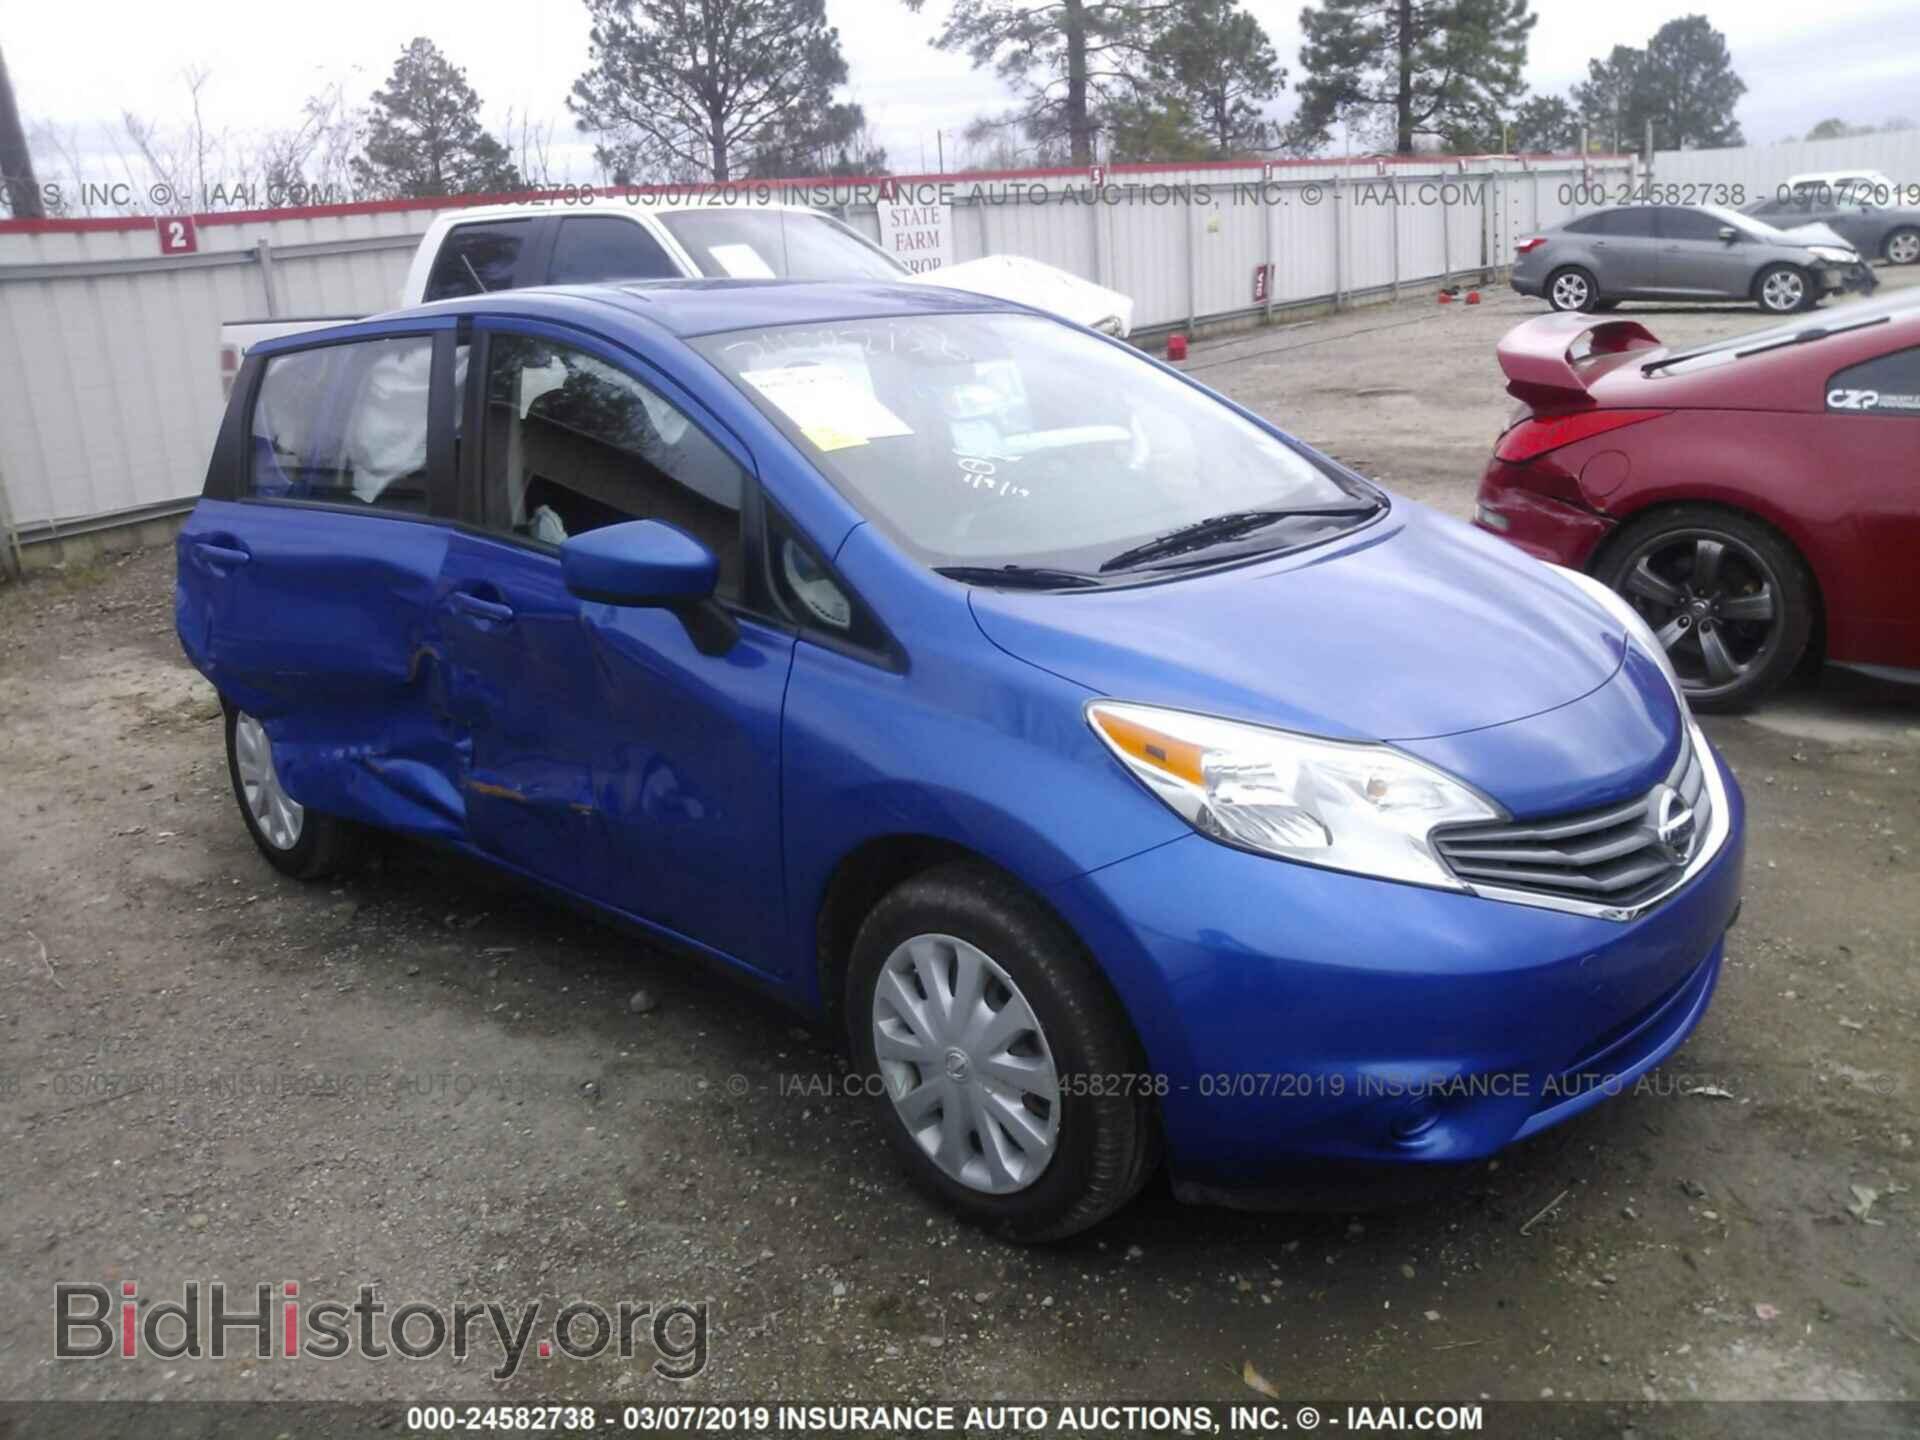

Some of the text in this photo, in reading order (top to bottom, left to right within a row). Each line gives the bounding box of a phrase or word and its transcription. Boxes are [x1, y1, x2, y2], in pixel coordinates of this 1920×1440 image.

[891, 206, 941, 227] STATE
[168, 222, 187, 247] 2
[896, 230, 940, 251] FARM
[903, 257, 942, 274] ROP
